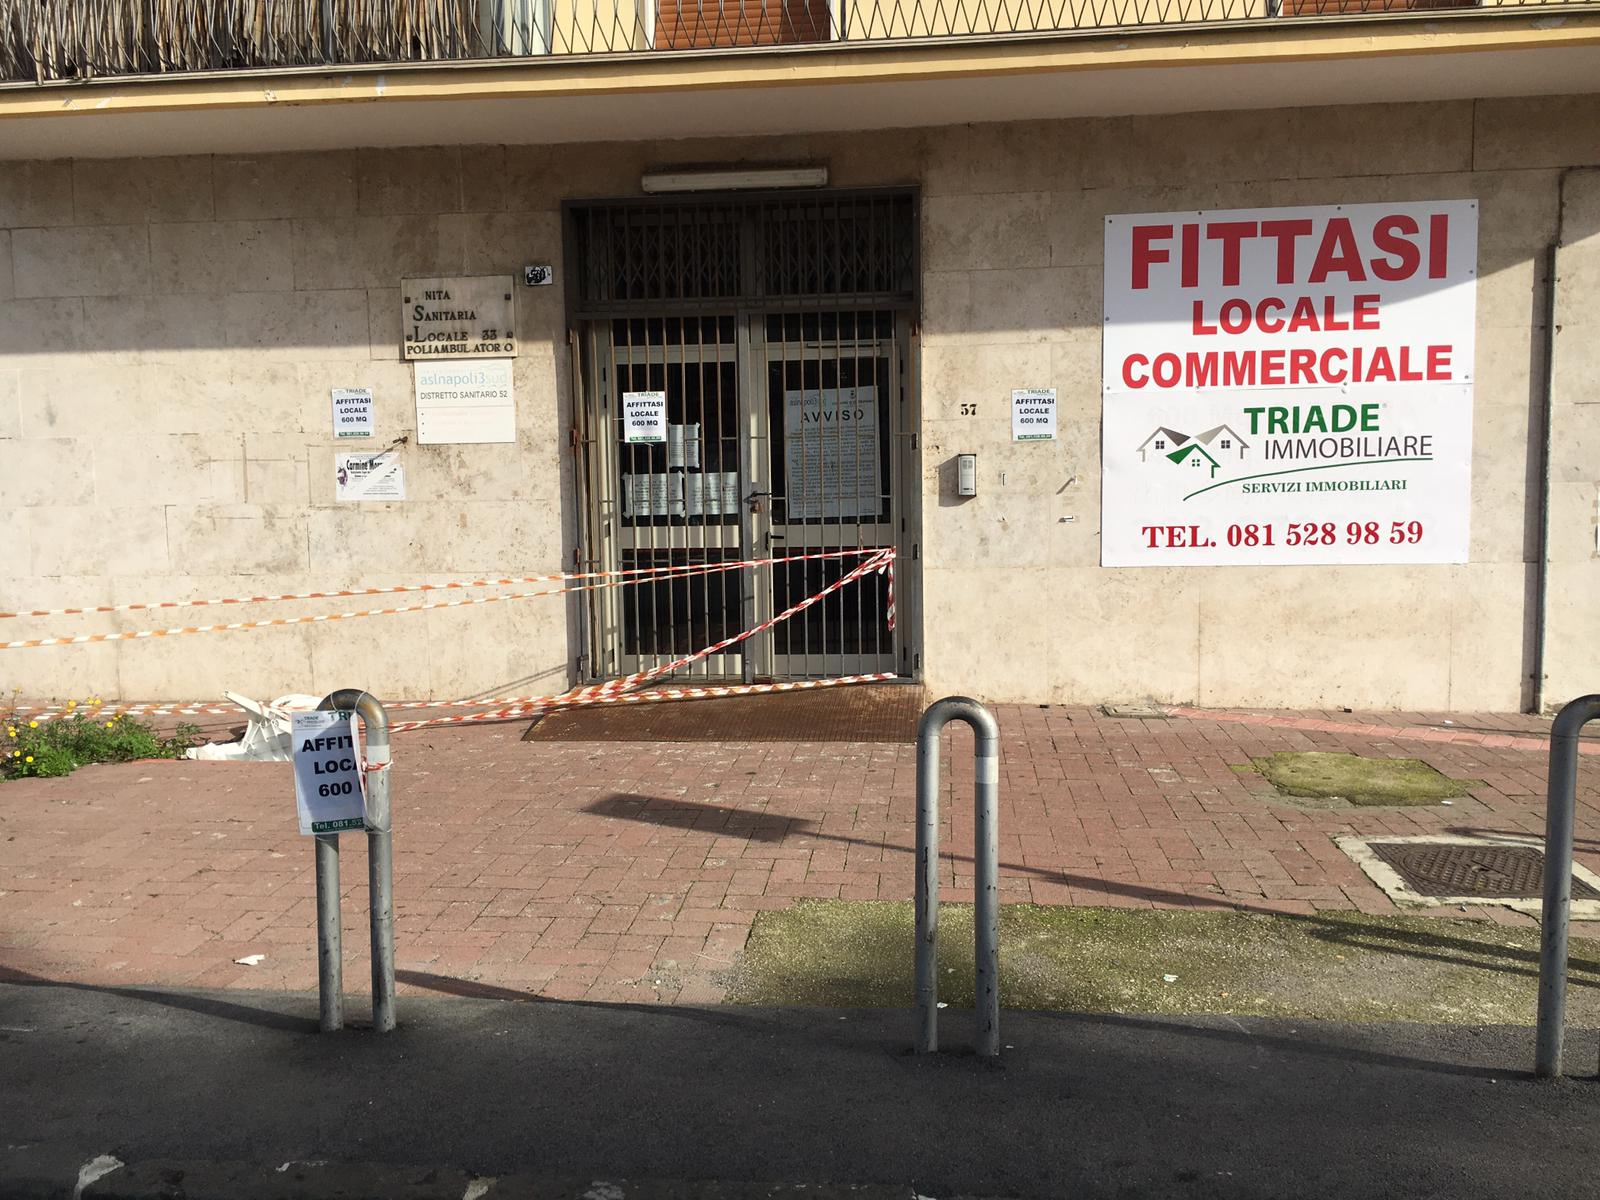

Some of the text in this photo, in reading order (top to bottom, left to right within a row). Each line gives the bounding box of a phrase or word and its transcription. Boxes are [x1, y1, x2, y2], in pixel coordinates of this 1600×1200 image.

[1131, 213, 1449, 289] FITTASI
[413, 305, 477, 321] SANITARIA
[1192, 294, 1381, 336] LOCALE
[414, 326, 497, 342] LOCALE 33
[1122, 344, 1453, 389] COMMERCIALE
[420, 390, 508, 399] DISTRETTO SANITARIO 52
[801, 409, 864, 423] AVVISO
[960, 404, 977, 416] 57
[1243, 403, 1380, 435] TRIADE
[1264, 435, 1433, 460] IMMOBILIARE
[1242, 479, 1407, 494] SERVIZI IMMOBILIARI
[1141, 520, 1424, 548] TEL. 081 528 98 59
[319, 781, 352, 797] 600
[314, 822, 330, 830] Tel.
